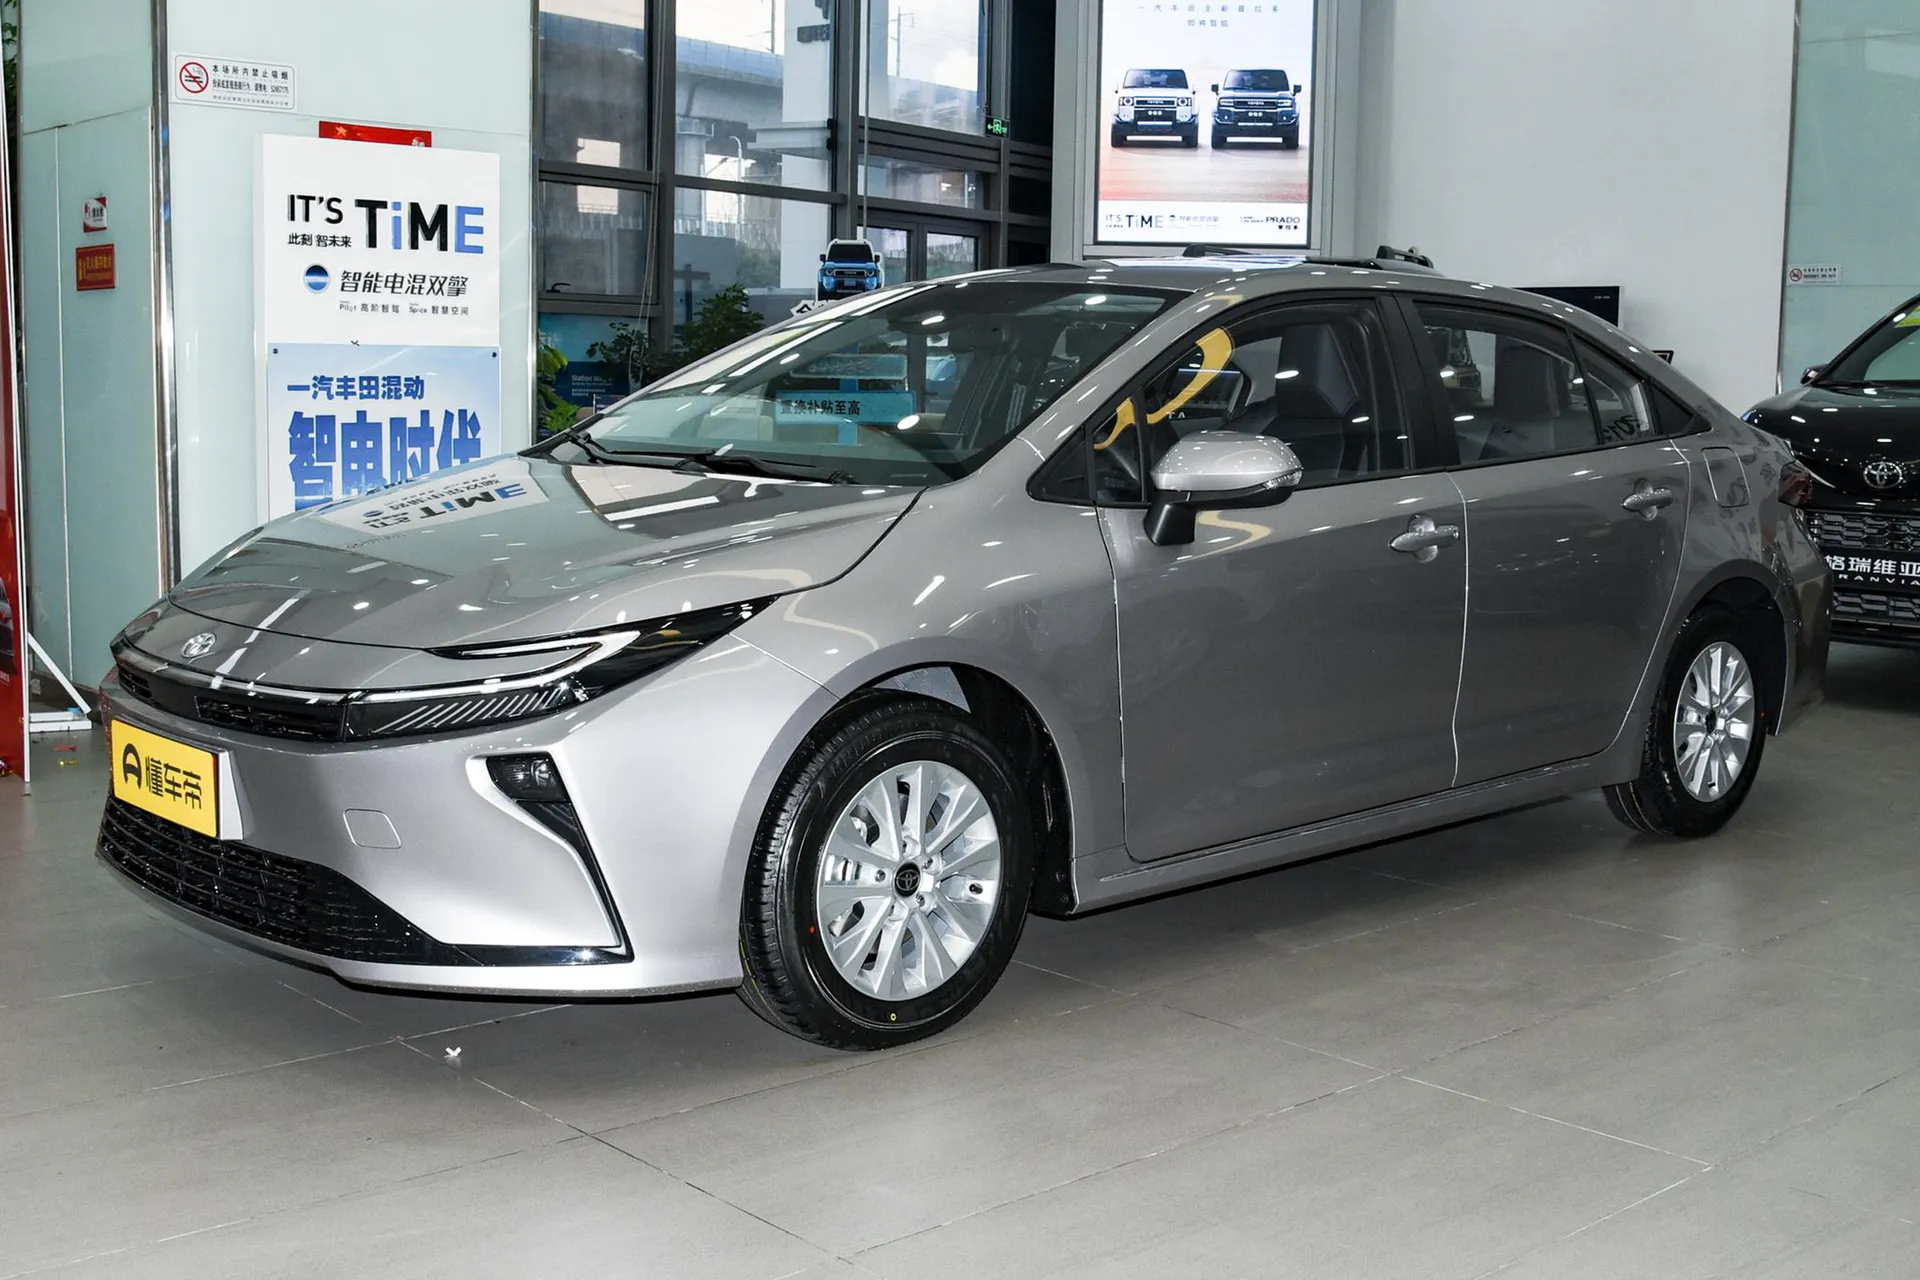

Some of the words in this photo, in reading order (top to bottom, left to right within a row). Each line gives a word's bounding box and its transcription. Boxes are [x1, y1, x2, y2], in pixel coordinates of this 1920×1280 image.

[212, 64, 289, 80] 本场所内禁止吸烟
[1265, 216, 1301, 224] PRADO
[288, 232, 313, 247] 此刻
[315, 234, 352, 249] 智未来
[339, 269, 469, 298] 智能电混双擎
[360, 303, 400, 314] 高阶智驾
[431, 305, 470, 316] 智慧空间
[287, 375, 425, 401] 一汽丰田混动
[288, 408, 481, 512] 智电时代
[1824, 555, 1920, 577] 格瑞维亚
[1838, 573, 1920, 586] RANVIA
[145, 756, 202, 810] 懂车帝
